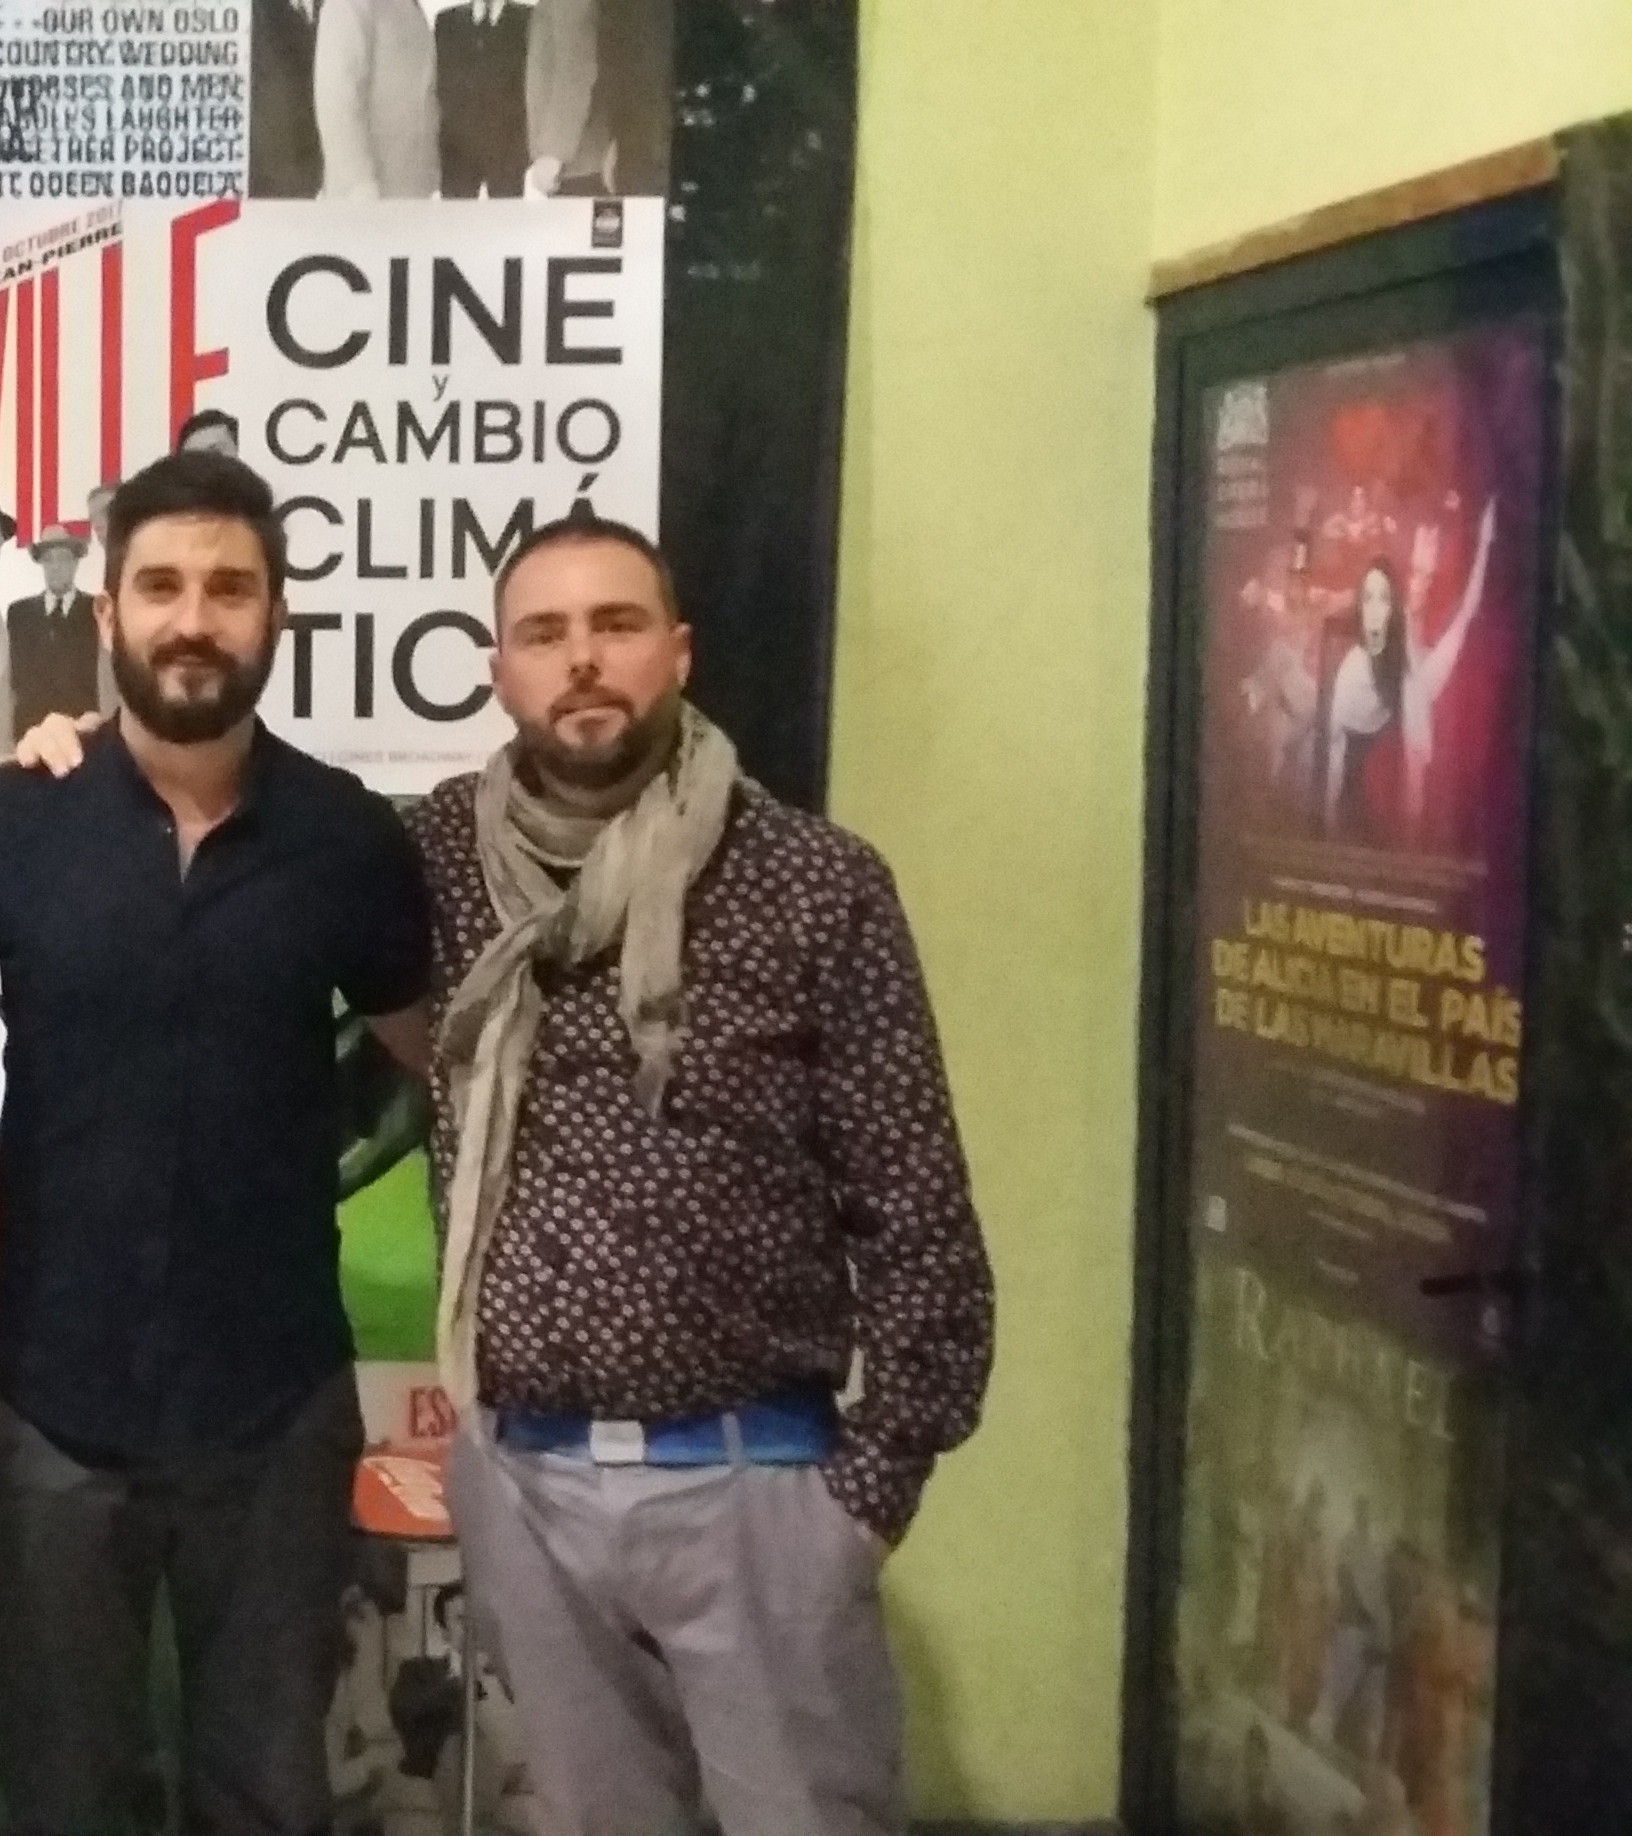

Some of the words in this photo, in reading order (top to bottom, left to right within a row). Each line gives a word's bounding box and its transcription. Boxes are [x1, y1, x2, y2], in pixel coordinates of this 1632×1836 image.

[42, 7, 93, 33] OUR
[103, 7, 164, 33] OWN
[174, 7, 239, 33] OSLO
[119, 40, 239, 66] WEDDING
[265, 253, 625, 370] CINE
[431, 372, 450, 400] y
[265, 397, 622, 466] CAMBIO
[1293, 907, 1486, 983] AVENTURAS
[1388, 977, 1430, 1029] EL
